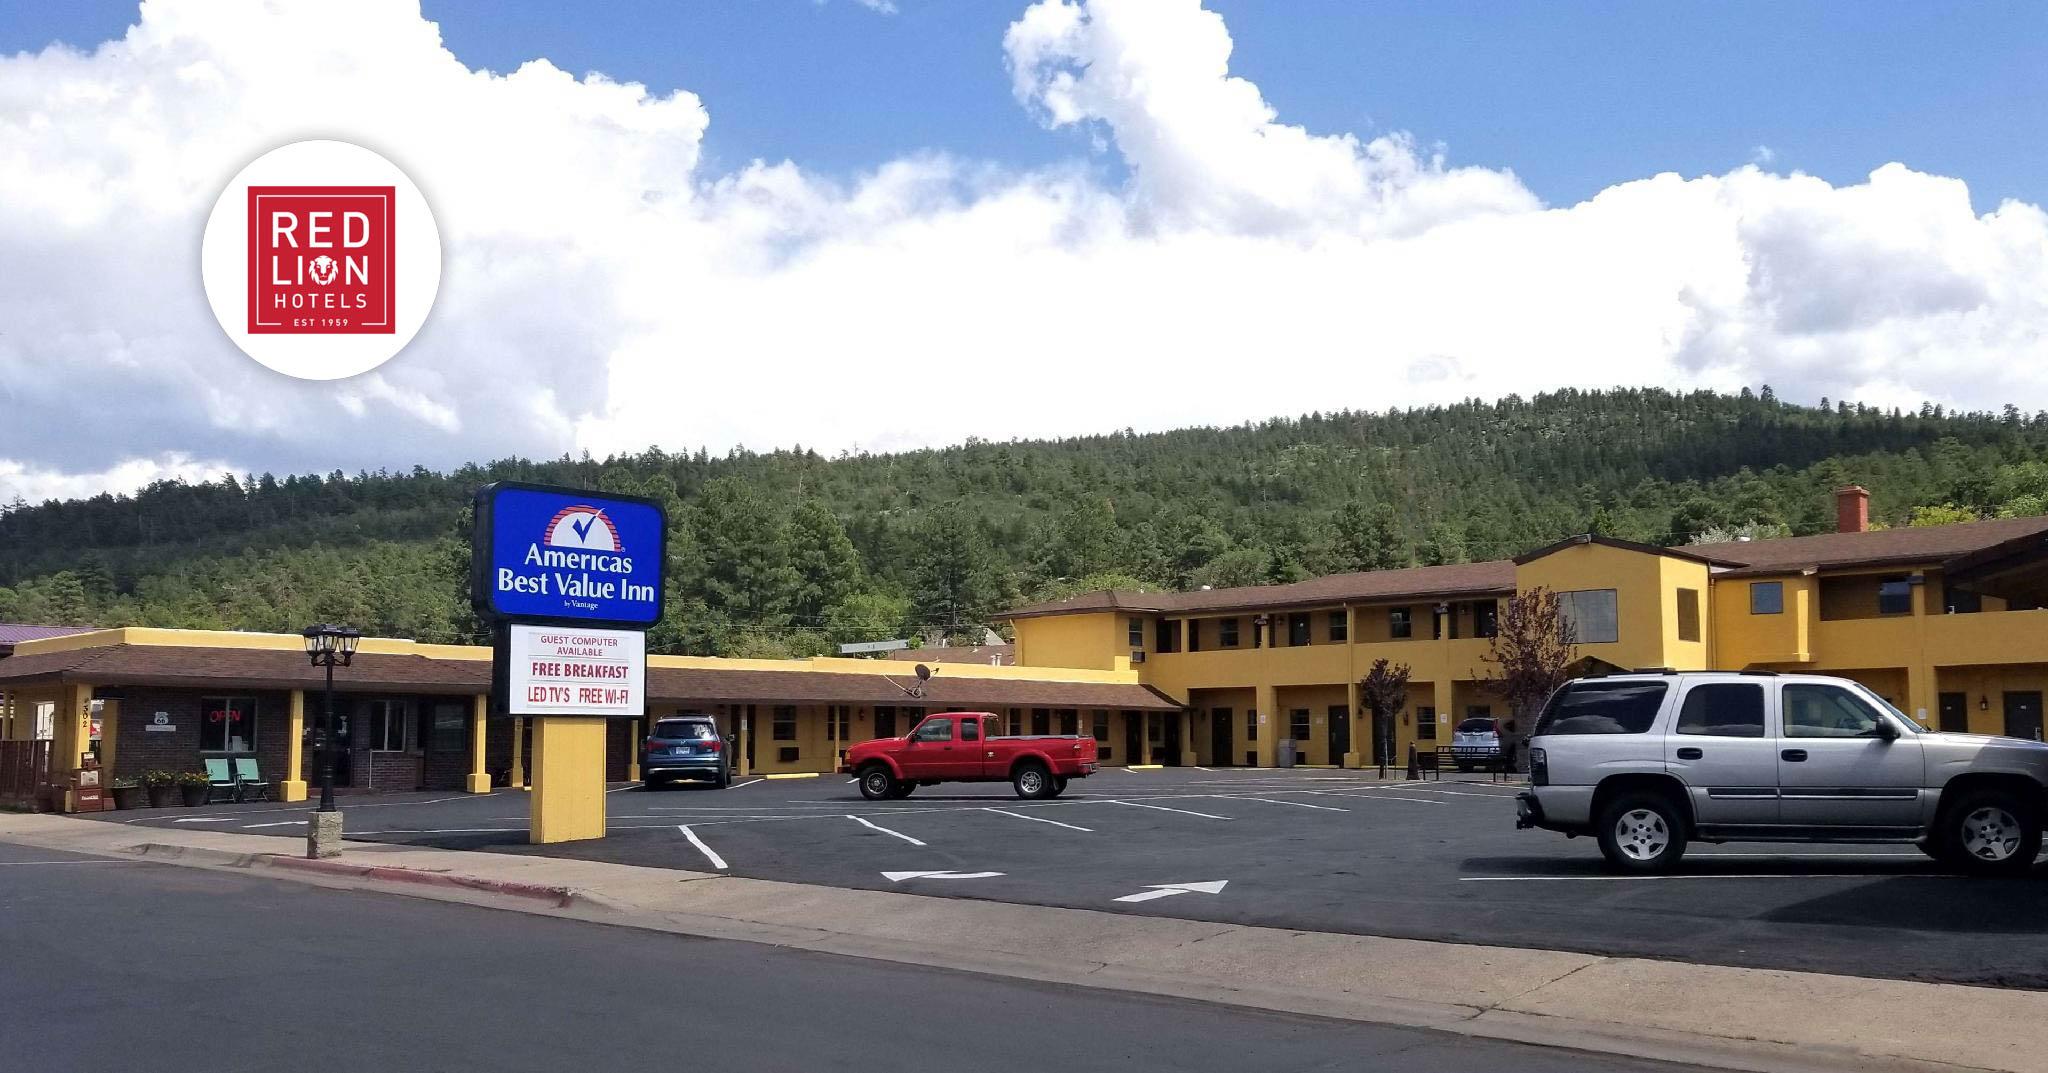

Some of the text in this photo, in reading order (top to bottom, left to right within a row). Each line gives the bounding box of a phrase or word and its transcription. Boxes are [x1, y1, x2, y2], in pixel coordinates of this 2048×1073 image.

[524, 543, 633, 574] Americas
[498, 567, 655, 603] Best Value Inn
[563, 600, 599, 611] by Vantage
[540, 635, 618, 647] GUEST COMPUTER
[556, 646, 603, 657] AVAILABLE
[532, 662, 629, 679] FREE BREAKFAST
[527, 686, 629, 705] LED TV'S FREE WI-FI
[209, 710, 240, 722] OPEN
